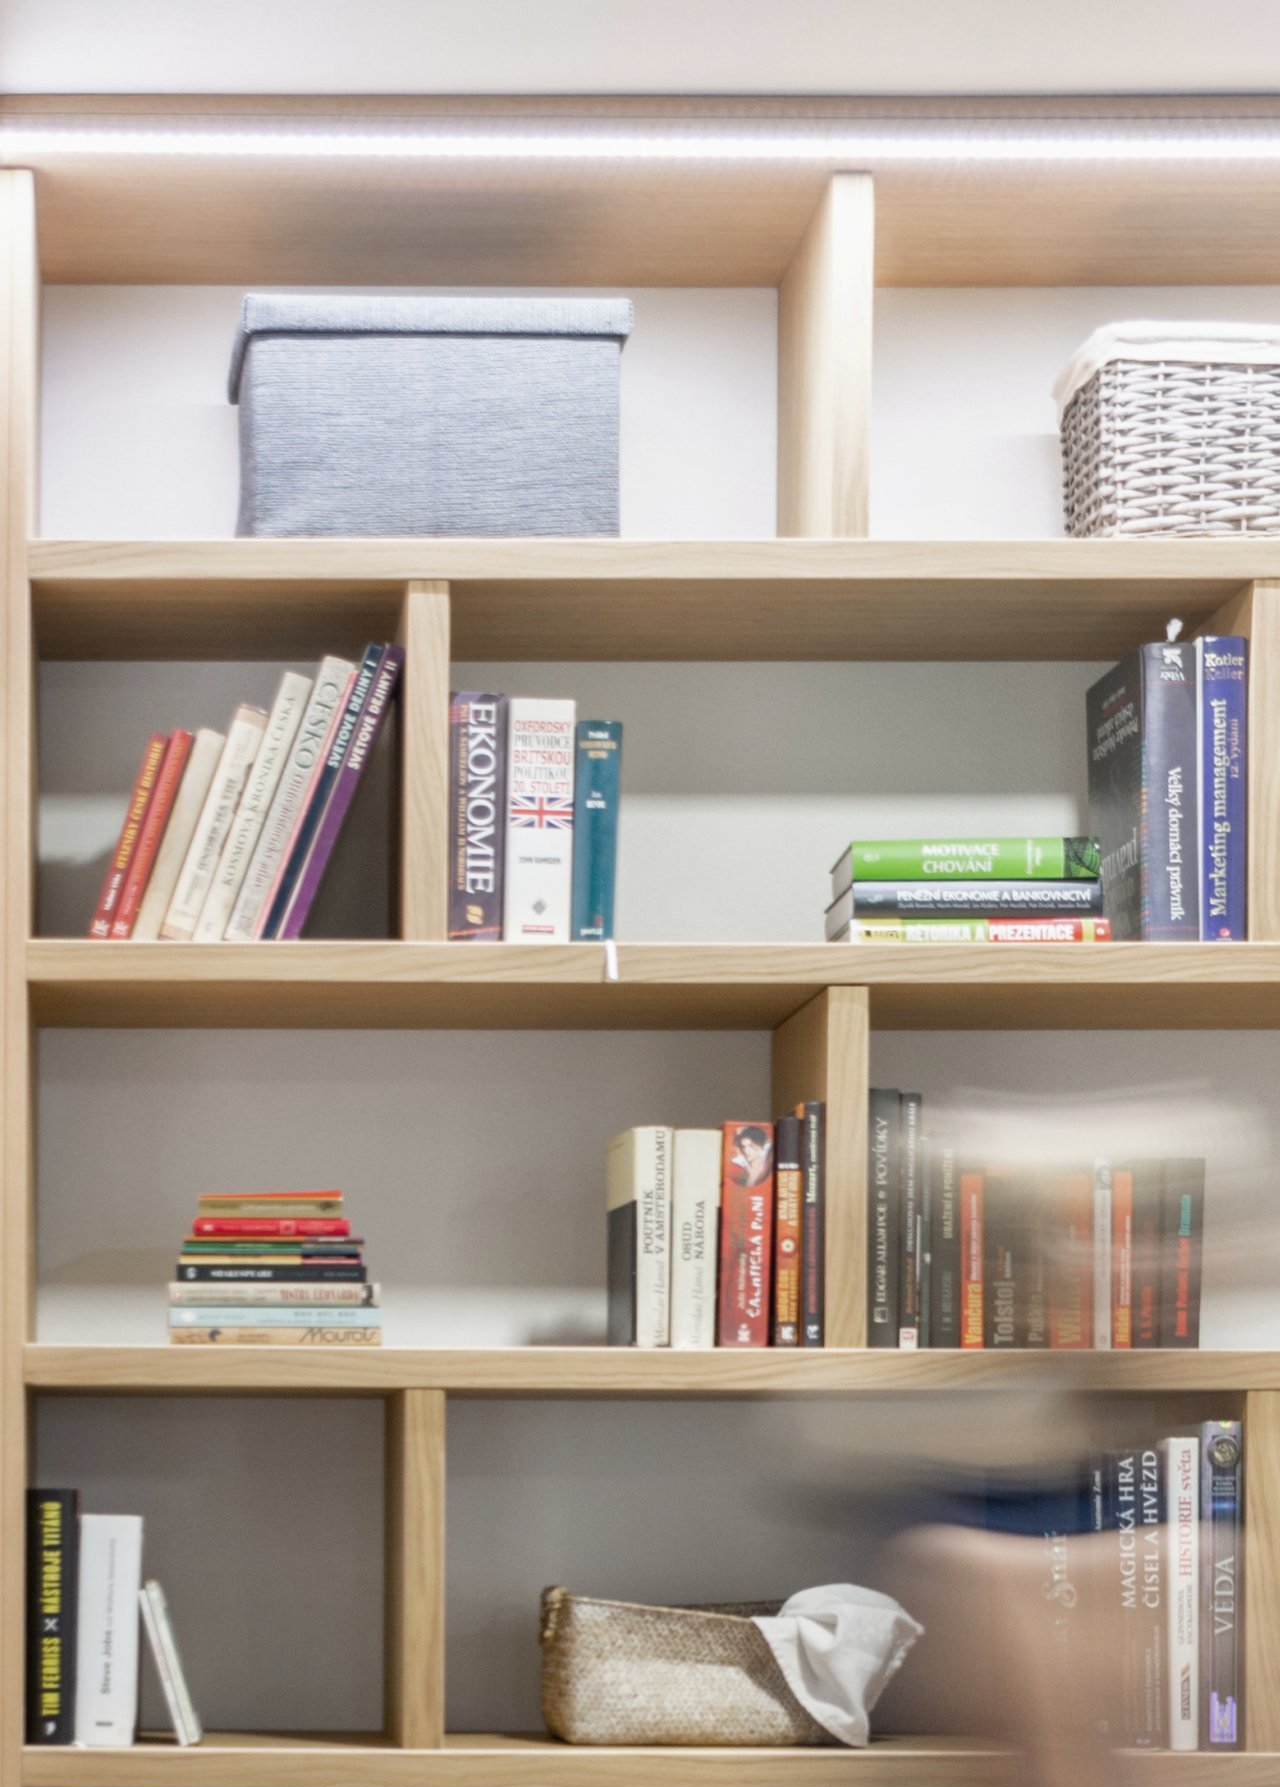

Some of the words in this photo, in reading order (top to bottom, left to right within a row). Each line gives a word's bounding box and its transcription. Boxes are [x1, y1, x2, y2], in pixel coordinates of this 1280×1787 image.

[1204, 653, 1244, 667] Kotler
[326, 713, 356, 768] SVĚTOVÉ
[348, 669, 373, 712] DĚJINY
[346, 714, 377, 770] SVĚTOVÉ
[367, 671, 393, 714] DĚJINY
[513, 750, 570, 764] BRITSKOU
[1165, 767, 1182, 806] Velký
[1208, 698, 1230, 817] management
[467, 702, 496, 893] EKONOMIE
[1168, 808, 1183, 863] domácí
[922, 858, 994, 874] CHOVÁNÍ
[1166, 866, 1185, 920] právník
[1208, 822, 1231, 917] Marketing
[872, 1117, 887, 1184] POVÍDKY
[655, 1130, 664, 1240] AMSTERODAMU
[875, 1203, 887, 1226] POE
[642, 1189, 653, 1253] POUTNÍK
[682, 1221, 692, 1260] OSUD
[692, 1200, 704, 1259] NÁRODA
[875, 1228, 887, 1261] ALLAN
[875, 1265, 887, 1302] EDGAR
[994, 1280, 1014, 1344] Tolstoj
[963, 1283, 981, 1344] Vančura
[1118, 1457, 1134, 1500] HRA
[1140, 1450, 1157, 1522] HVĚZD
[1176, 1449, 1191, 1490] světa
[40, 1501, 61, 1545] TITÁNŮ
[1178, 1495, 1191, 1576] HISTORIE
[39, 1550, 61, 1613] NÁSTROJE
[1116, 1508, 1136, 1607] MAGICKÁ
[1142, 1548, 1159, 1607] ČÍSEL
[1210, 1555, 1234, 1633] VĚDA
[42, 1637, 59, 1687] FERRISS
[42, 1692, 59, 1715] TIM
